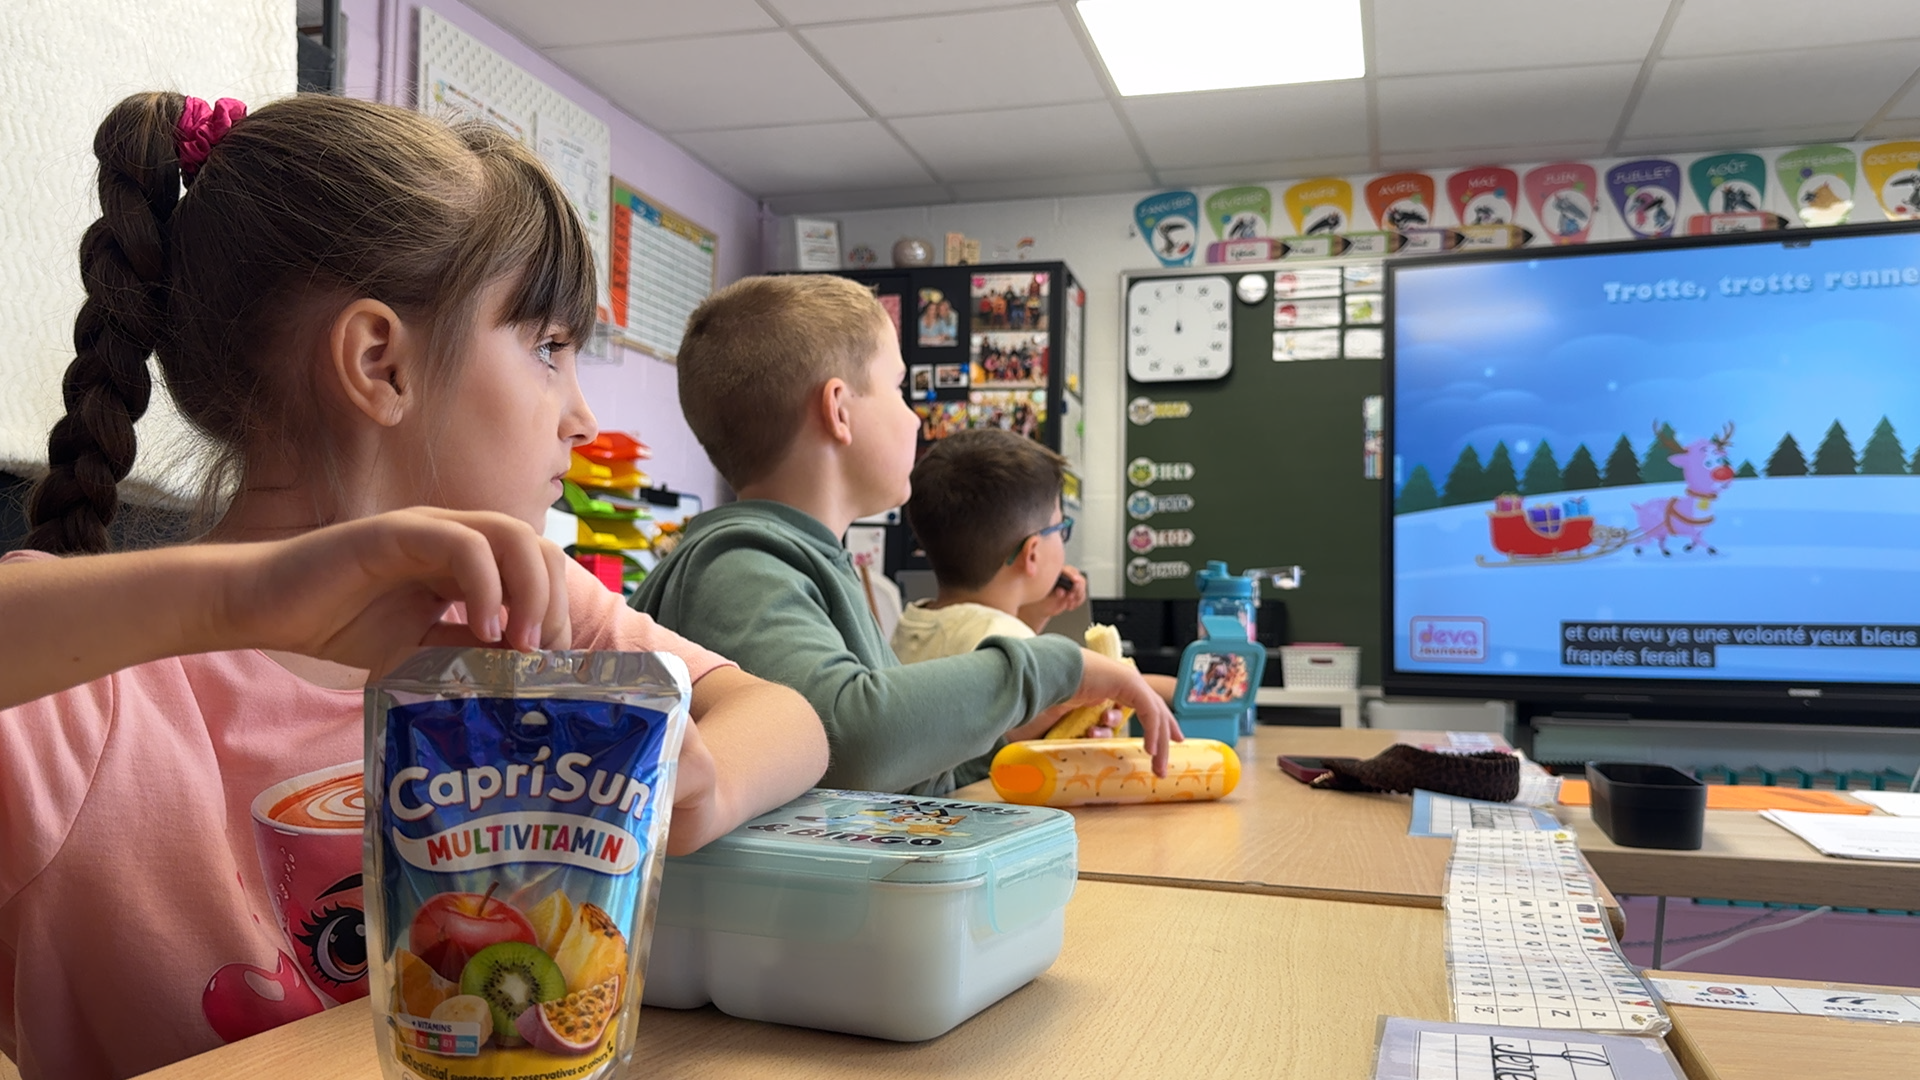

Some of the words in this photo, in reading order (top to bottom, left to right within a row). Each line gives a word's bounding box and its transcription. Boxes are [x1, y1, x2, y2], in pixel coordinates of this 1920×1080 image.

[1544, 172, 1577, 186] JUIN
[1613, 166, 1673, 185] JUILLET
[1603, 278, 1706, 302] Trotte,
[1719, 271, 1812, 296] trotte
[1419, 623, 1478, 646] deva
[1565, 624, 1586, 642] et
[1587, 625, 1621, 642] ont
[1622, 627, 1665, 643] revu
[1666, 627, 1691, 647] ya
[1693, 628, 1732, 643] une
[1732, 625, 1807, 644] volonté
[1809, 629, 1858, 648] yeux
[1861, 625, 1918, 646] bleus
[1565, 645, 1638, 667] frappés
[1640, 646, 1691, 667] ferait
[1693, 647, 1712, 667] la
[426, 824, 624, 866] MULTIVITAMIN
[784, 827, 944, 847] BINGO
[1694, 996, 1758, 1006] super
[1824, 1005, 1899, 1015] encore
[417, 1020, 452, 1033] VITAMINS
[413, 1060, 448, 1080] artificial
[511, 1066, 577, 1080] preservatives
